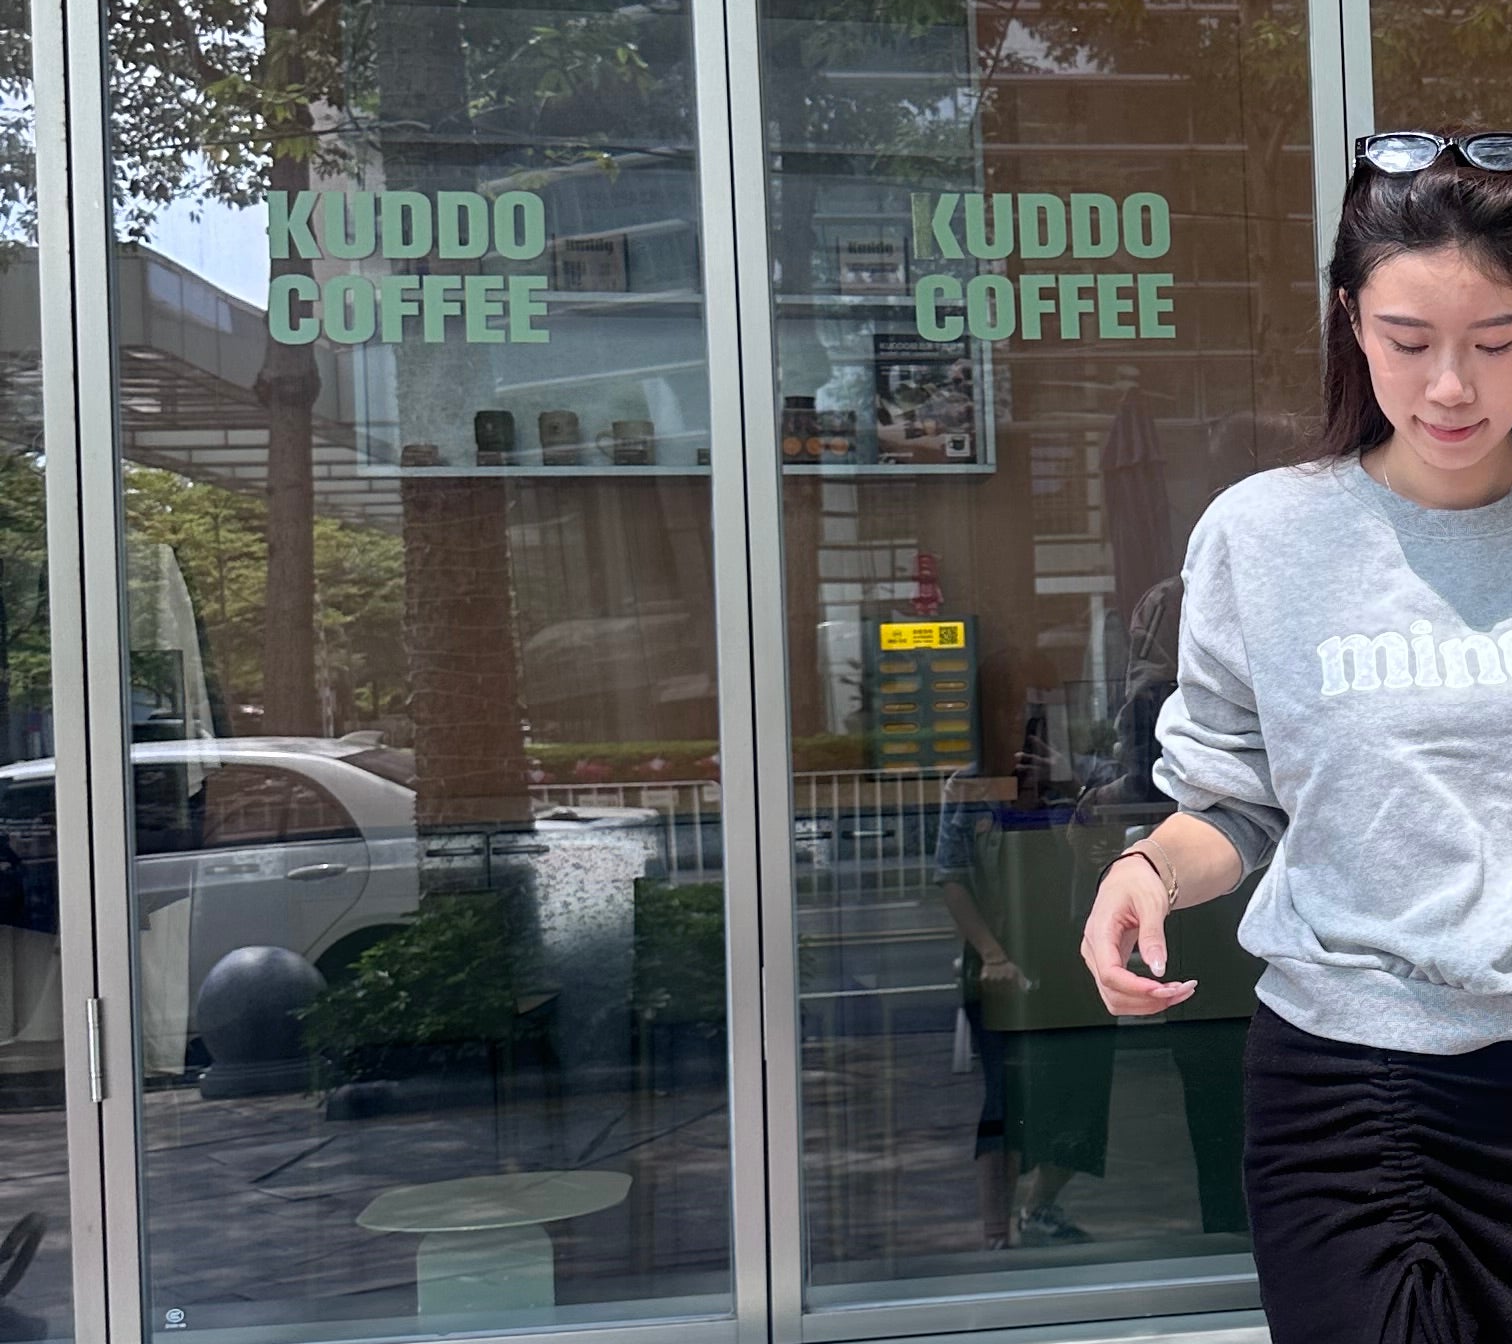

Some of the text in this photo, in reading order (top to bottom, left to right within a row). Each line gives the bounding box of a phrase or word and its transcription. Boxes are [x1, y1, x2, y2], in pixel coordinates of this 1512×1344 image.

[269, 191, 546, 260] KUDDO
[910, 192, 1171, 259] KUDDO
[269, 274, 550, 345] COFFEE
[914, 273, 1177, 342] COFFEE
